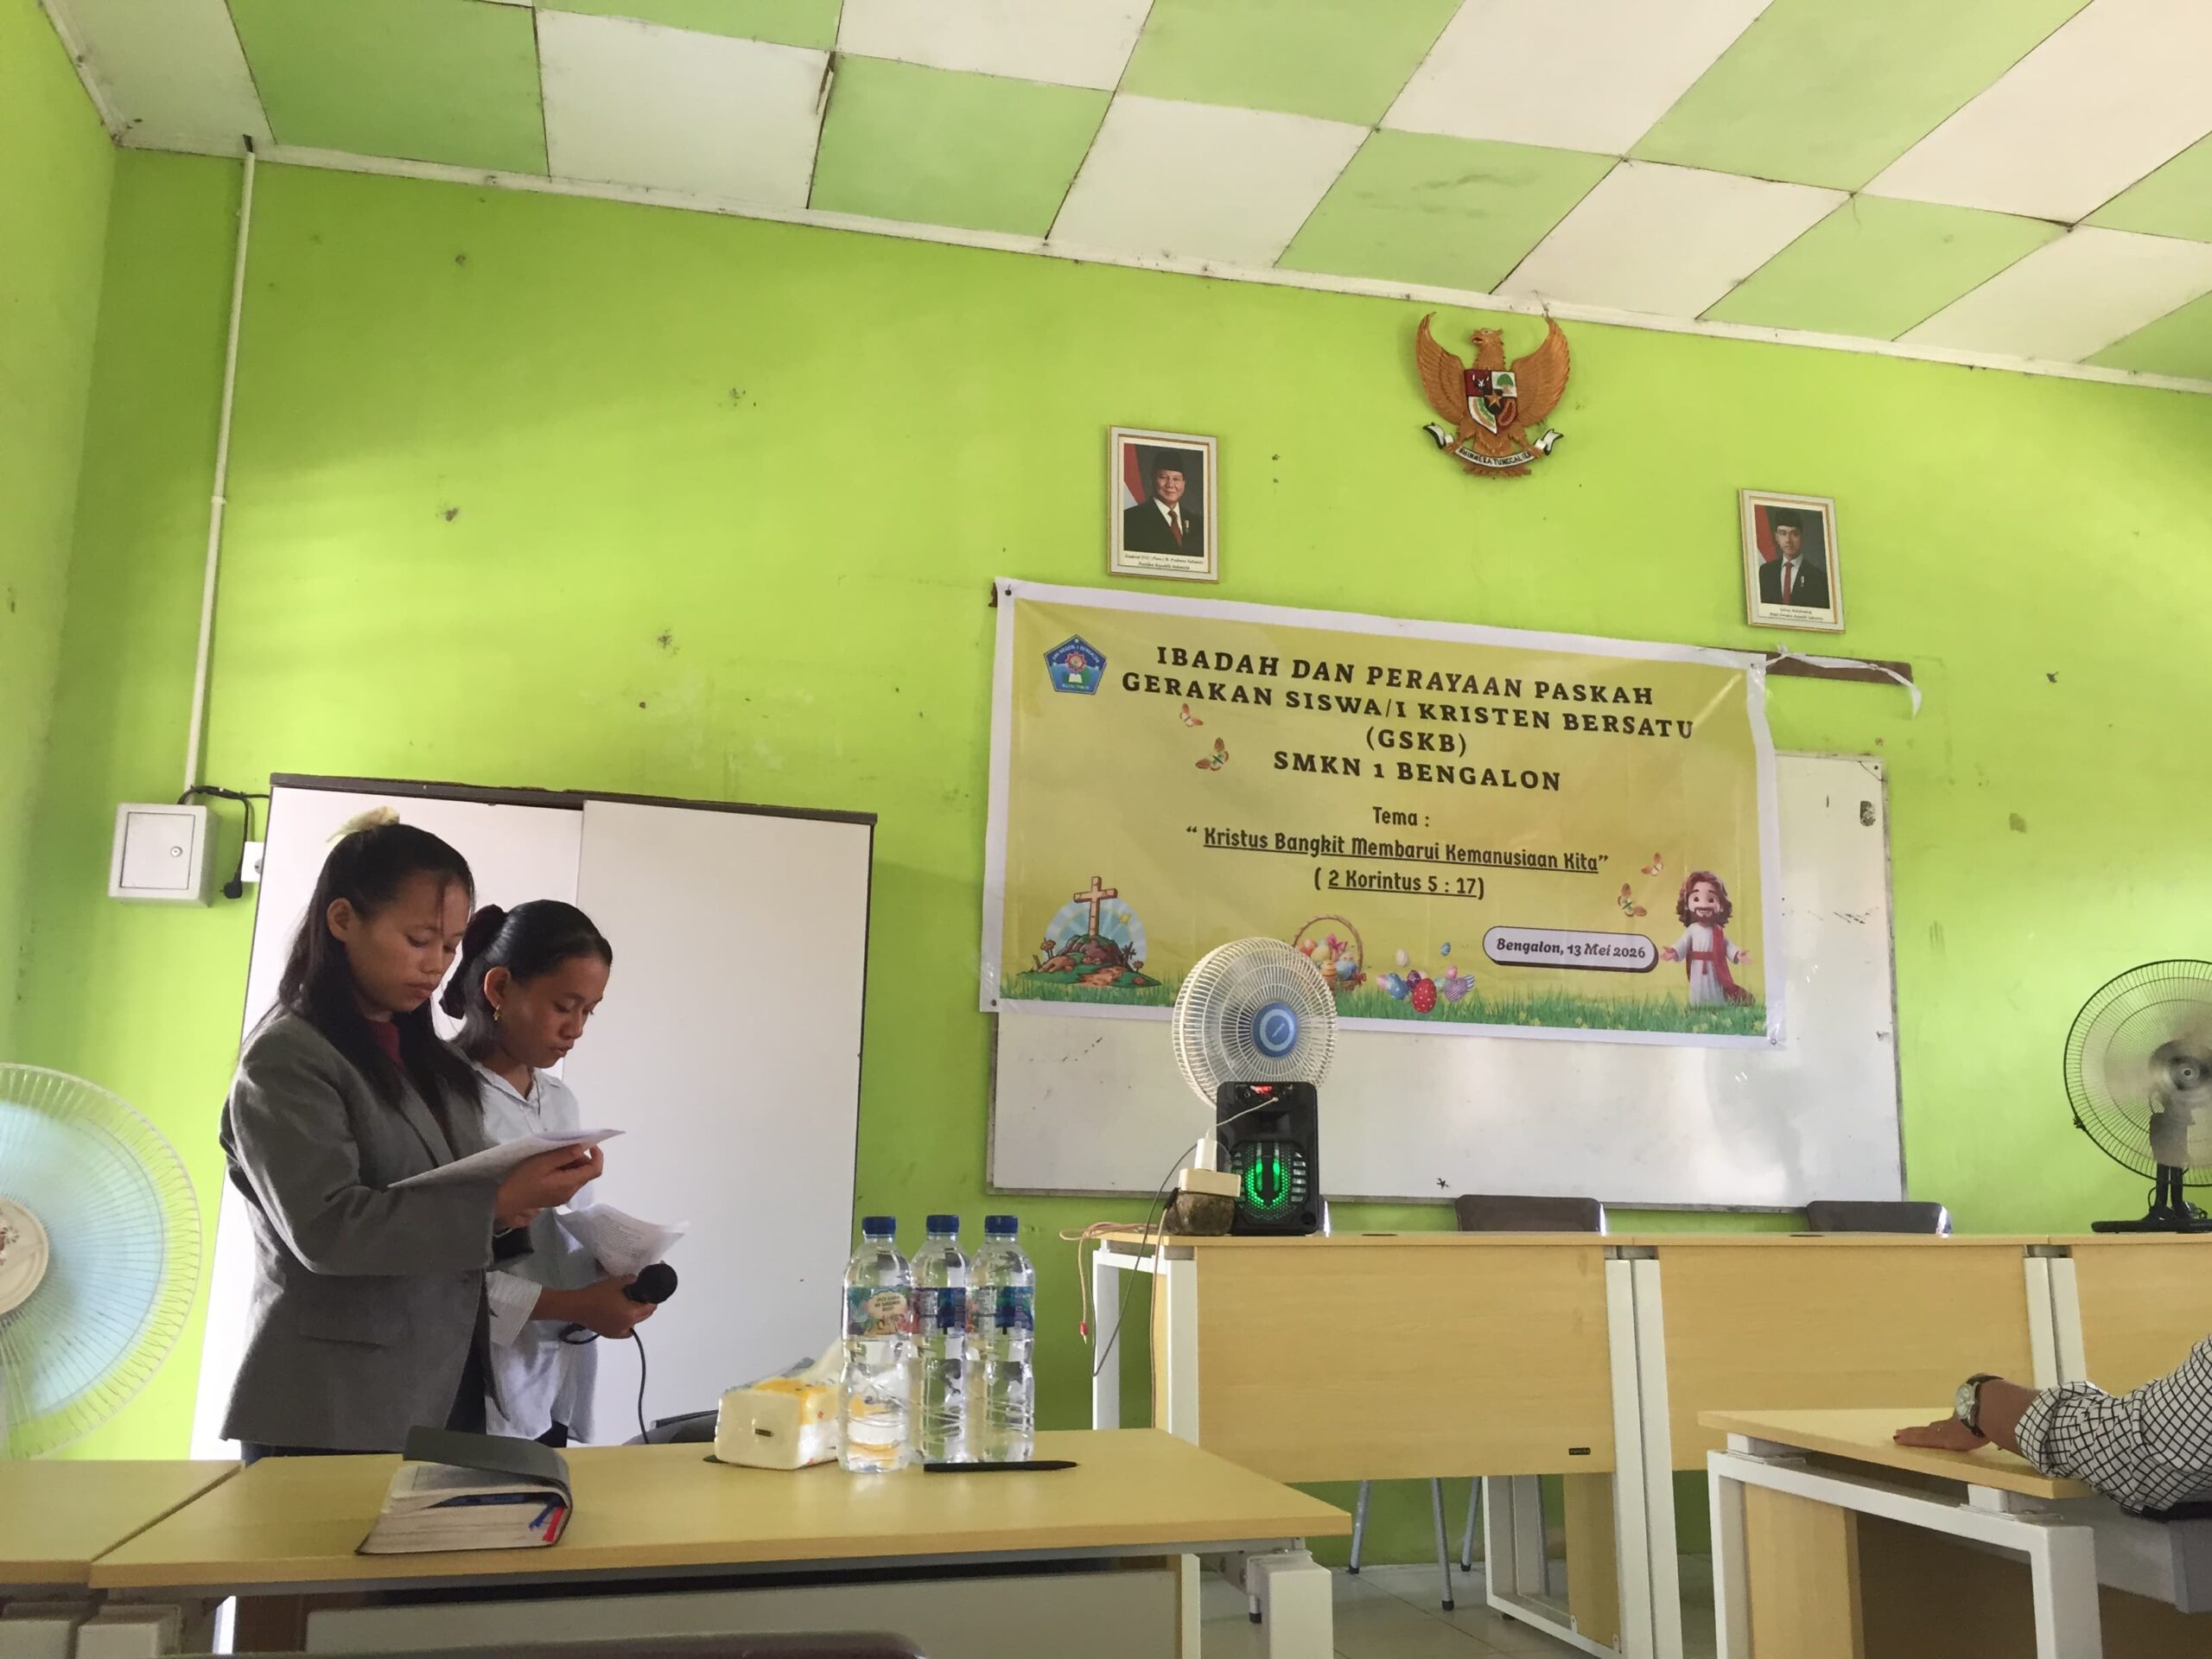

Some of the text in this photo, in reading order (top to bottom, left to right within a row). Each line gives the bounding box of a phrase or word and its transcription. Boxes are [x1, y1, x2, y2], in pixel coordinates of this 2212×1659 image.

[1156, 645, 1653, 706] IBADAH DAN PERAYAAN PASKAH
[1122, 671, 1694, 740] GERAKAN SISWA/I KRISTEN BERSATU
[1366, 726, 1467, 758] (GSKB)
[1274, 750, 1560, 791] SMKN 1 BENGALON
[1371, 805, 1418, 827] Tema
[1204, 826, 1268, 849] Kristus
[1274, 832, 1345, 858] Bangkit
[1351, 836, 1440, 861] Membarui
[1445, 843, 1558, 869] Kemanusiaan
[1328, 869, 1339, 887] 2
[1345, 869, 1422, 892] Korintus
[1456, 876, 1484, 901] 17)
[1496, 938, 1646, 959] Bengalon, 13 Mei 2026
